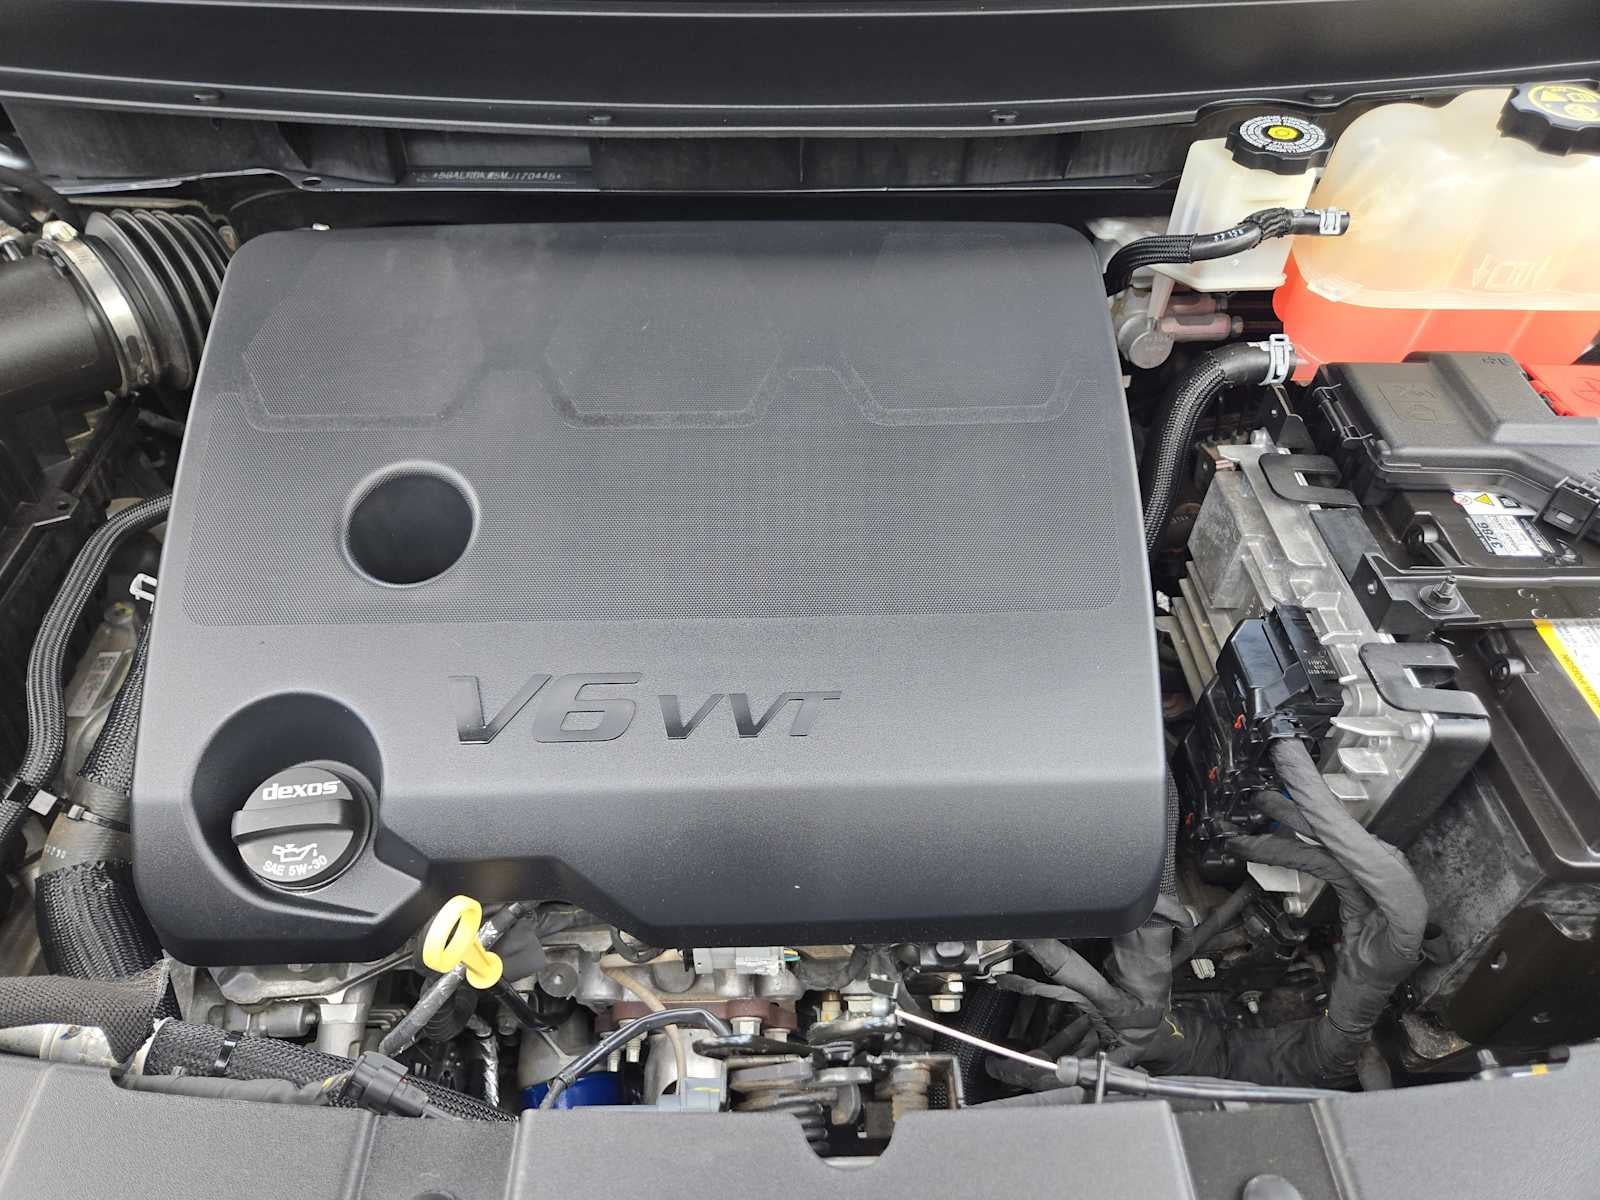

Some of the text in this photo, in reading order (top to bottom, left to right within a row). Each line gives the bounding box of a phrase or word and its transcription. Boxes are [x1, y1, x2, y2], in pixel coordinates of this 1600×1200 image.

[447, 671, 843, 745] V6 VVT
[262, 780, 339, 801] dexos
[262, 855, 328, 876] SAE 5W-30
